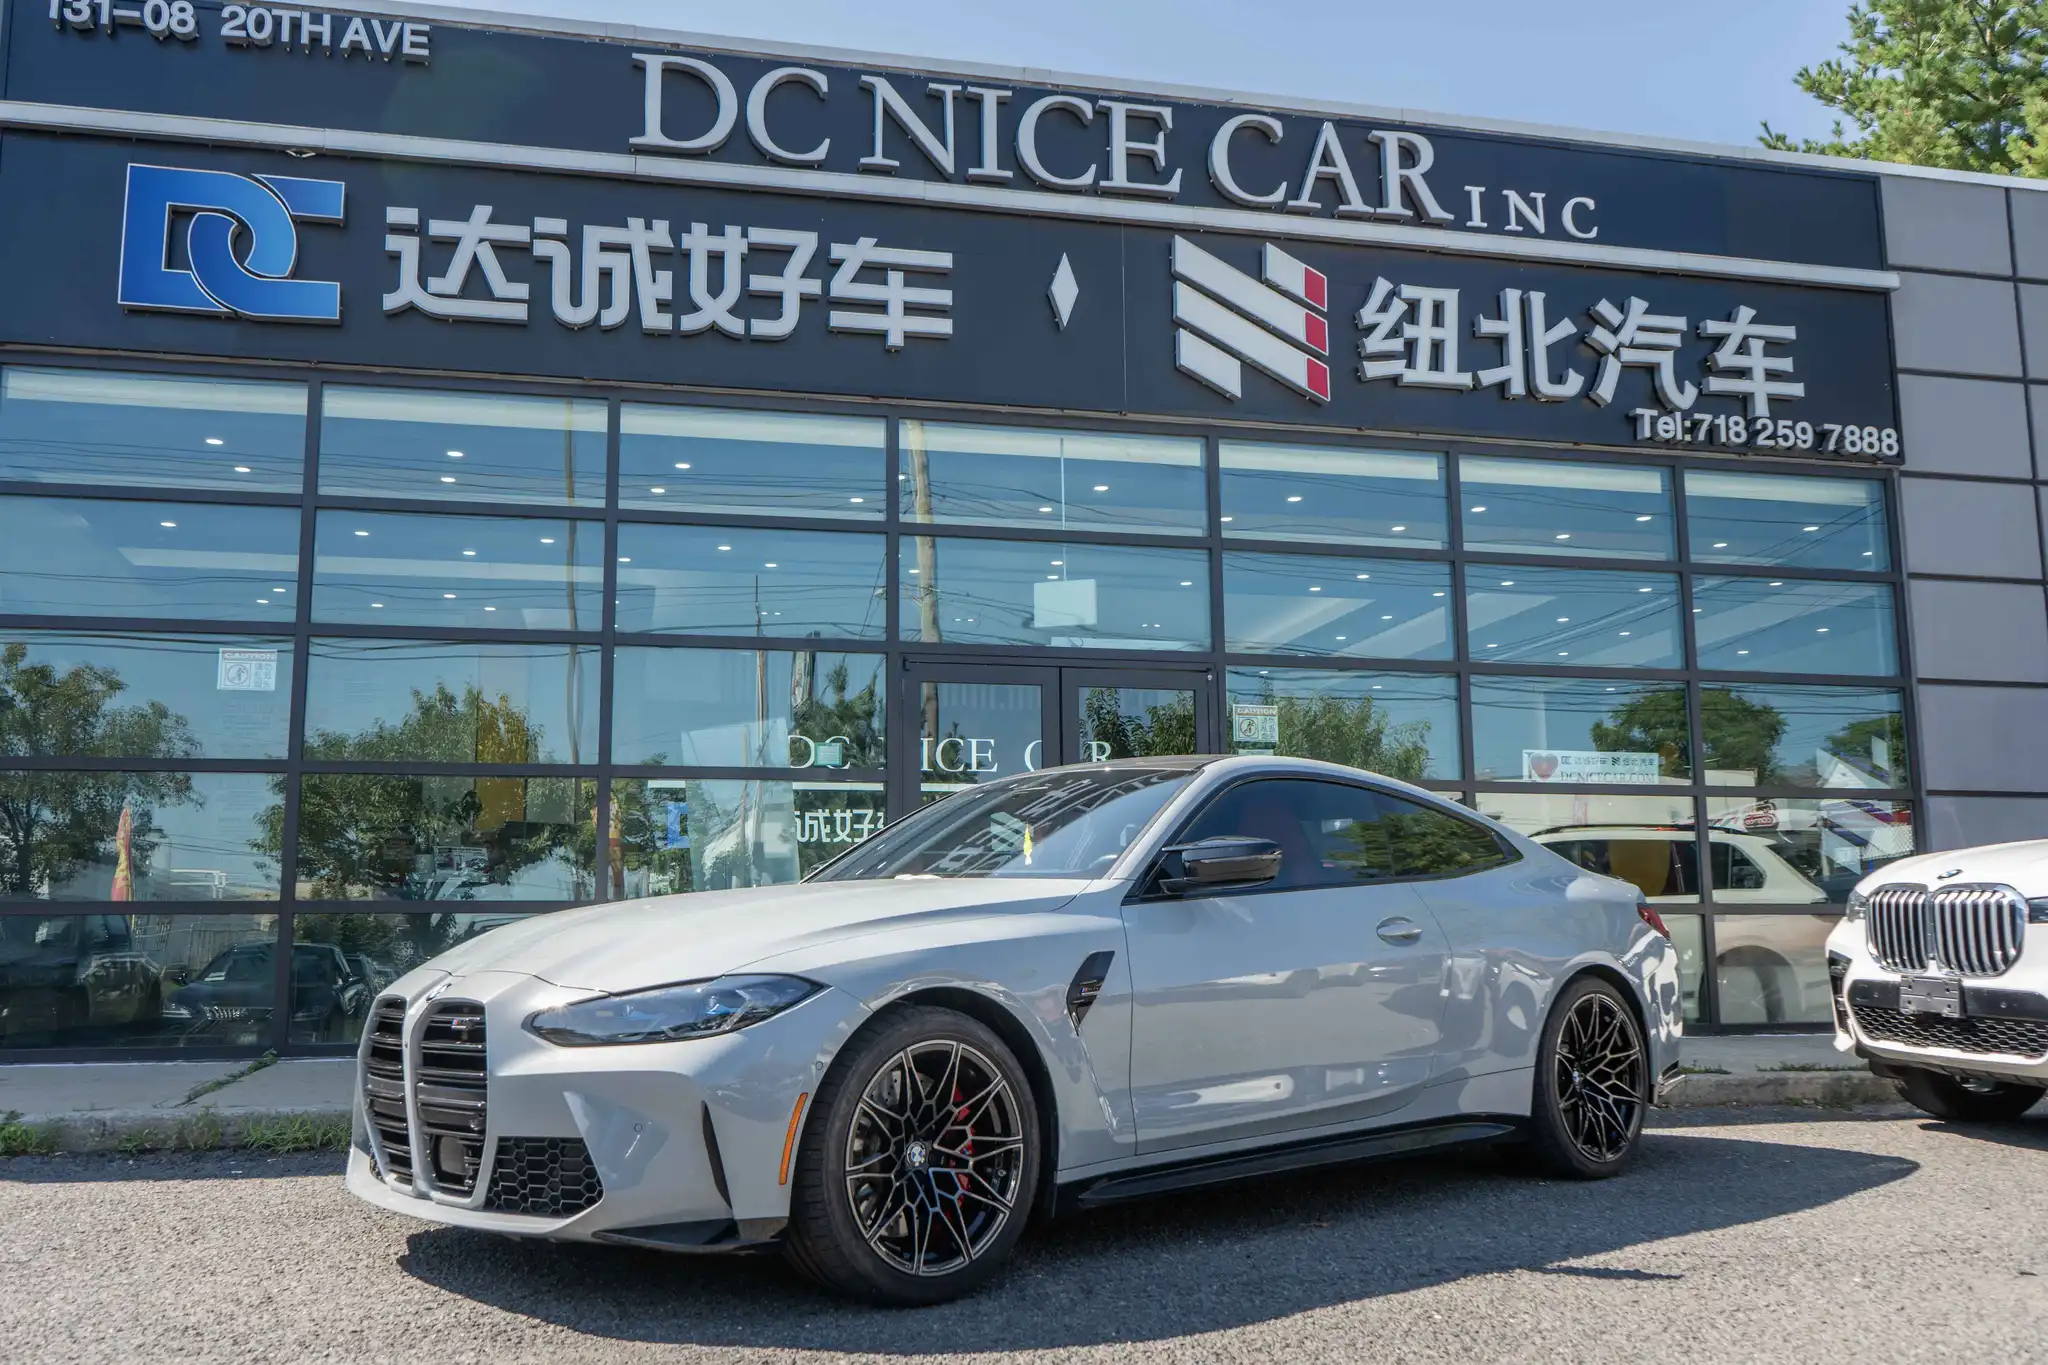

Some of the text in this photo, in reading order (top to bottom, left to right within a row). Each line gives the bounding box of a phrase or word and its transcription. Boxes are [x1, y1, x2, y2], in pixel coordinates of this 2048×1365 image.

[49, 0, 430, 58] 131-08 20TH AVE
[628, 53, 1600, 240] DC NICE CAR INC
[383, 204, 954, 351] 达诚好车
[1356, 275, 1805, 419] 纽北汽车
[1755, 417, 1814, 449] 259
[1822, 423, 1900, 456] 7888
